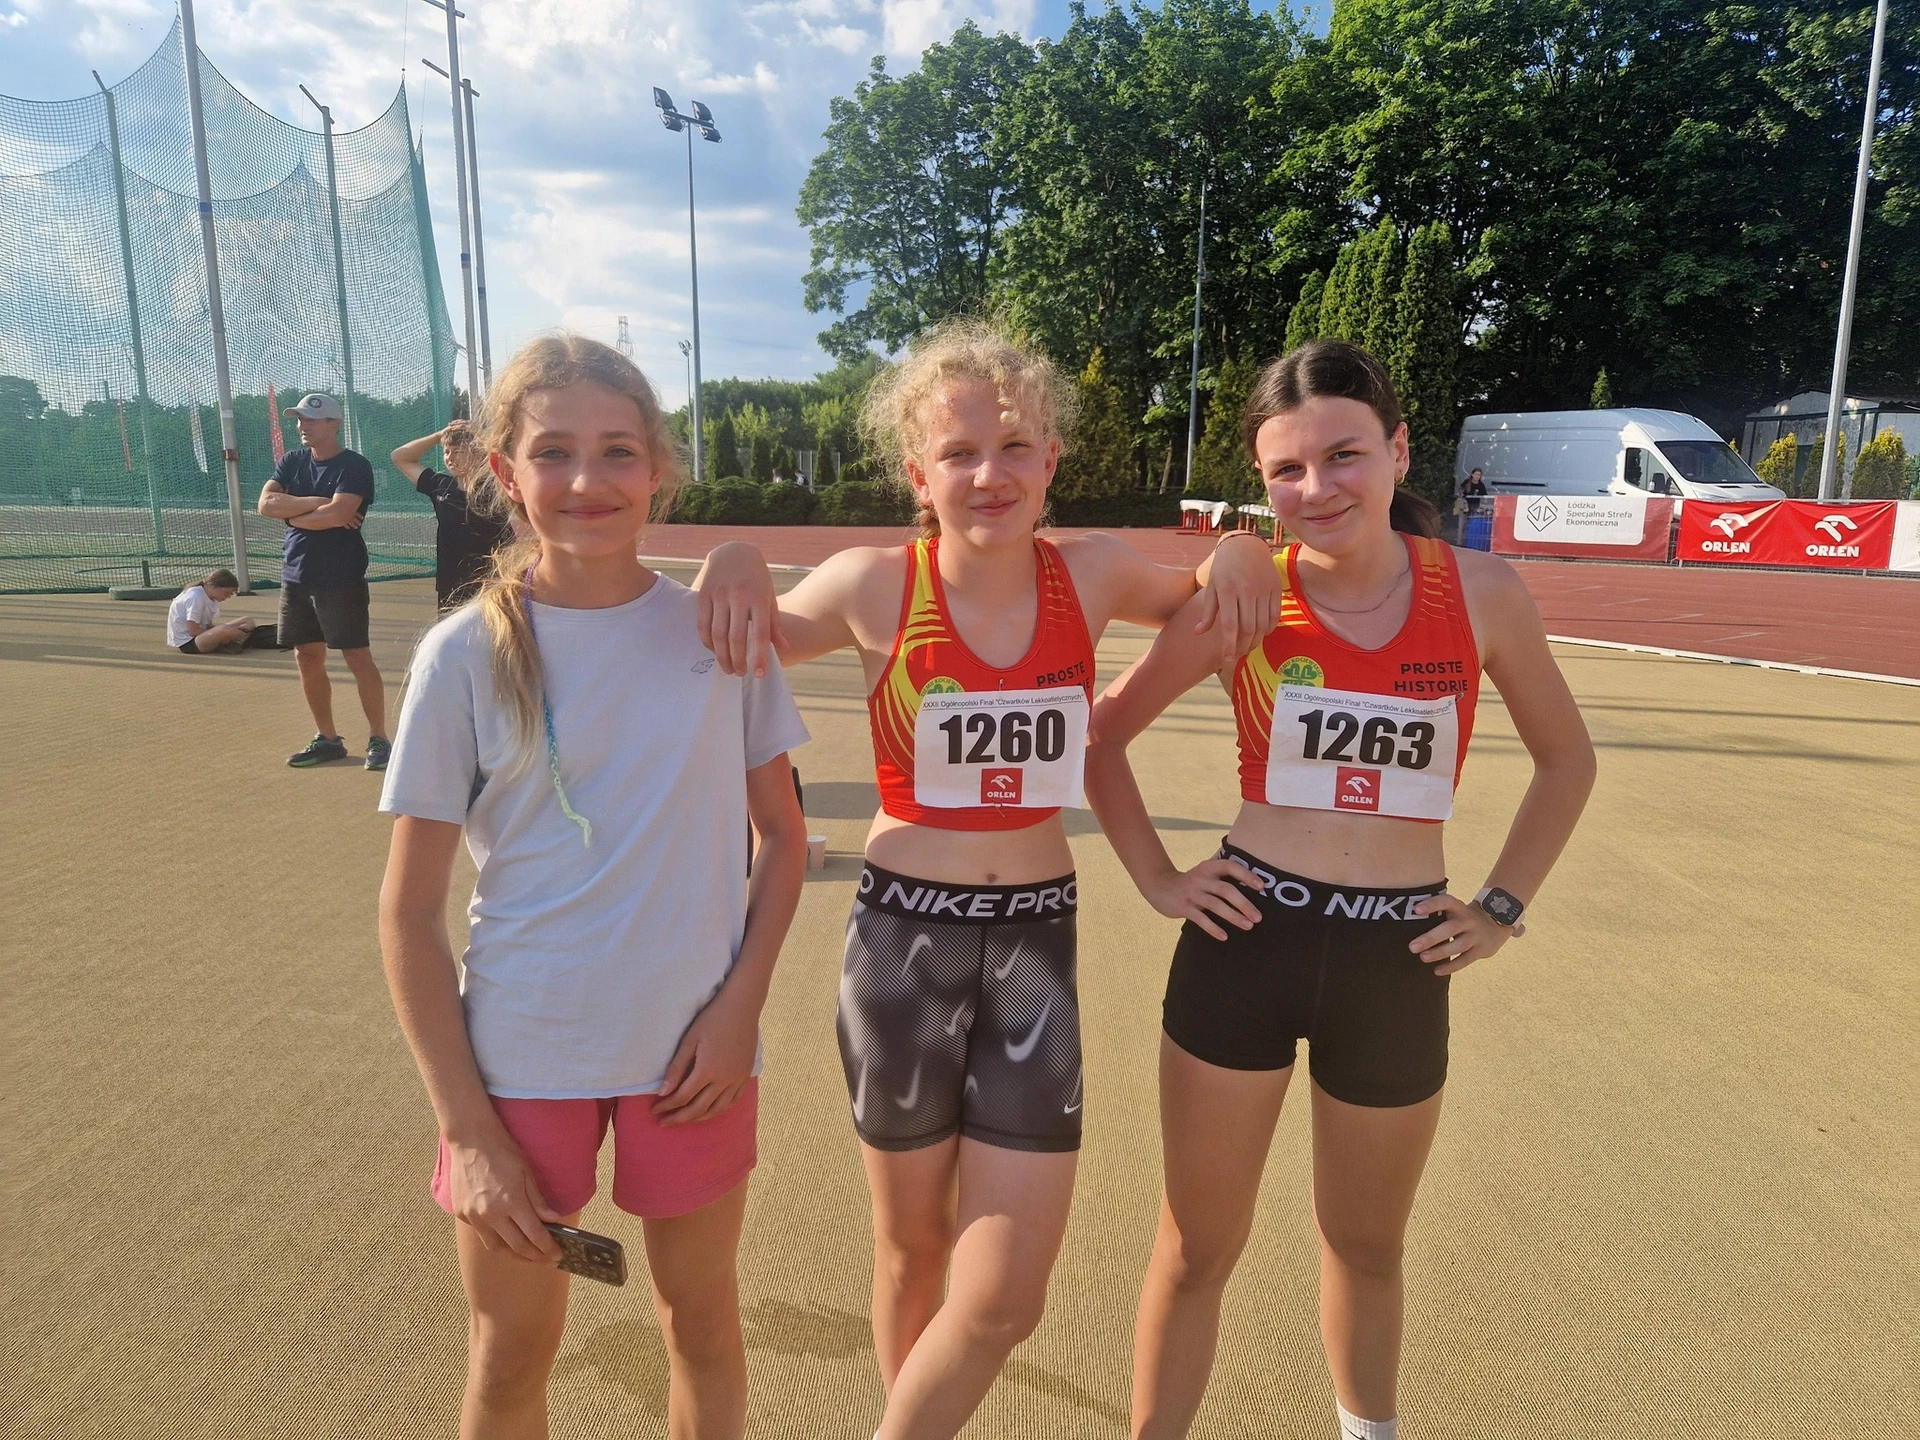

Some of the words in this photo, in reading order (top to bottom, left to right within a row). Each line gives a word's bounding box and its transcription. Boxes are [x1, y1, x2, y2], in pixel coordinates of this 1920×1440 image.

[1566, 510, 1605, 519] Specjalna
[1607, 510, 1633, 518] Strefa
[1565, 519, 1619, 527] Ekonomiczna
[1701, 540, 1750, 554] ORLEN
[1805, 544, 1860, 558] ORLEN
[1036, 661, 1086, 687] PROSTE
[1400, 661, 1463, 675] PROSTE
[1394, 679, 1468, 693] HISTORIE
[940, 700, 979, 708] Ogólnopolski
[1303, 693, 1345, 705] Ogólnopolski
[1344, 699, 1361, 707] Finał
[1362, 701, 1400, 711] "Czwartków
[938, 709, 1066, 764] 1260
[1298, 709, 1435, 770] 1263
[986, 791, 1016, 799] ORLEN
[1341, 794, 1373, 805] ORLEN
[880, 881, 1003, 917] NIKE
[1005, 881, 1077, 916] PRO
[1323, 892, 1431, 921] NIKE
